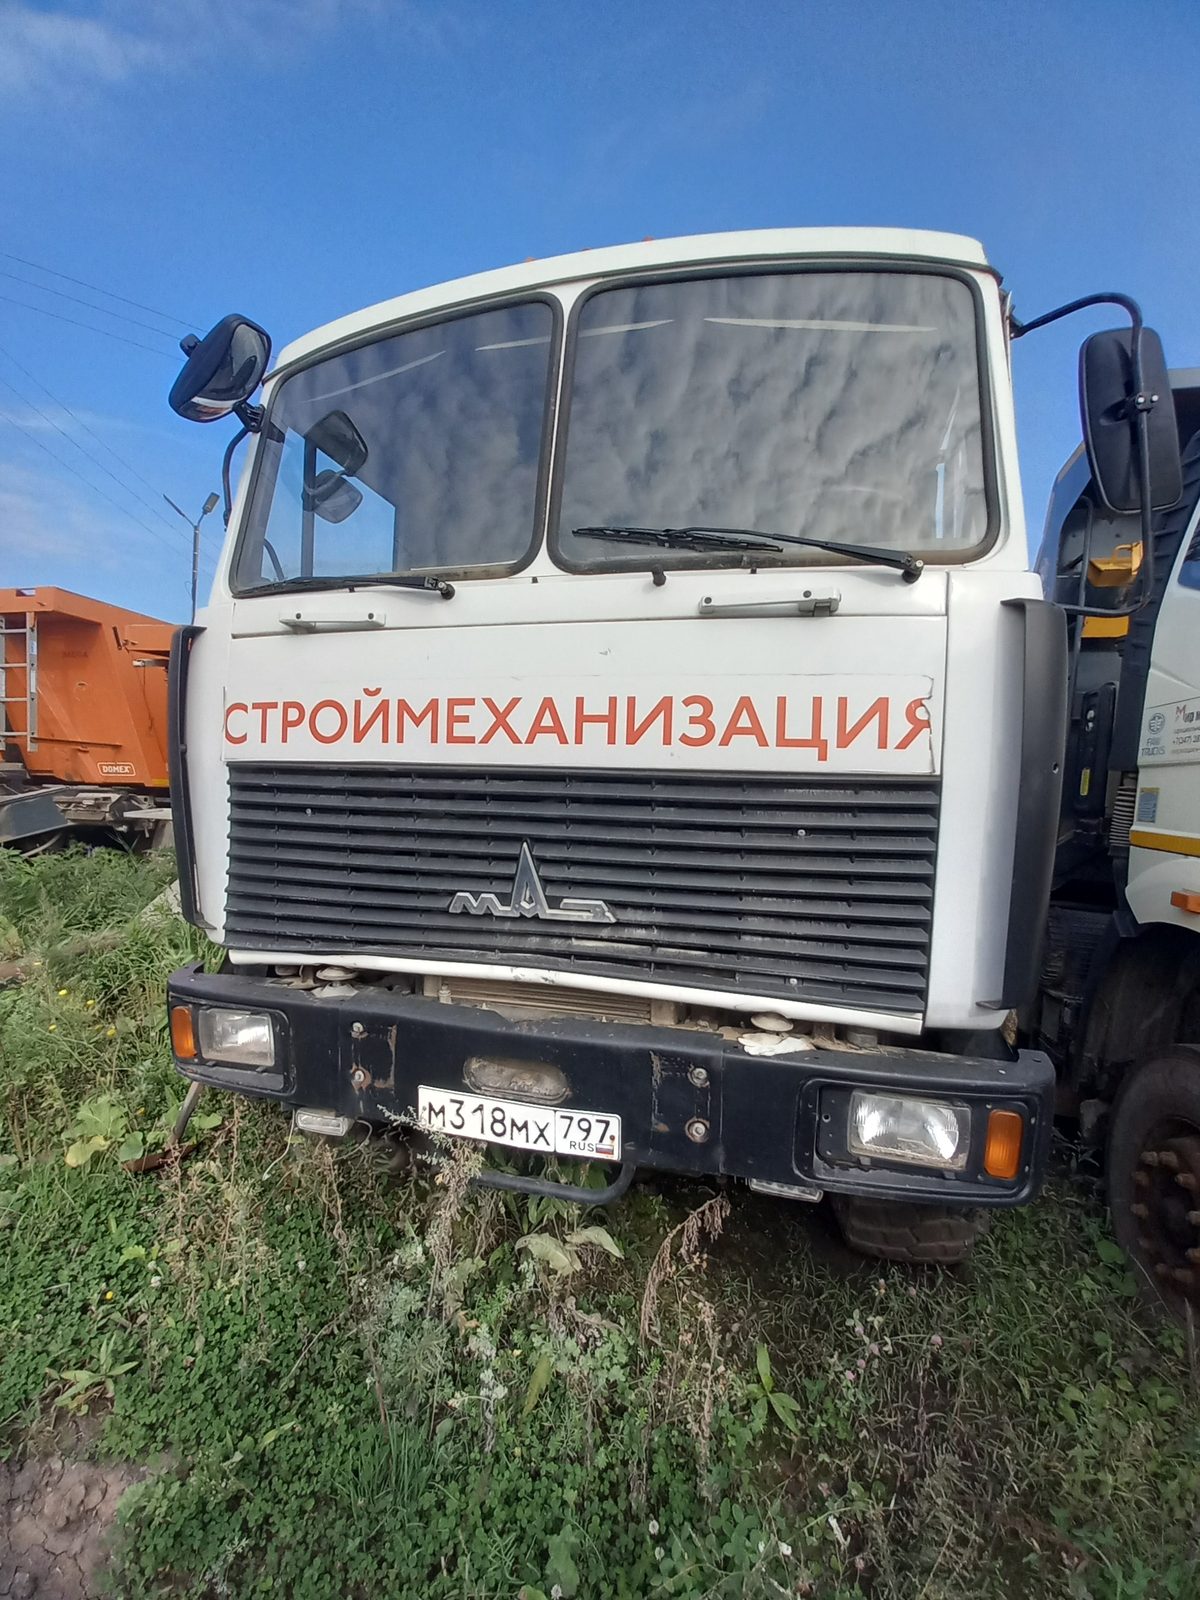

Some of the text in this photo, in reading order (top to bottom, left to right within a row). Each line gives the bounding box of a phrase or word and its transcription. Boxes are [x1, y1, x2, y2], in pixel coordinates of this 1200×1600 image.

[224, 687, 931, 762] СТРОЙМЕХАНИЗАЦИЯ
[102, 765, 131, 774] DOMEX
[560, 1114, 610, 1144] 797
[569, 1140, 595, 1153] RUS
